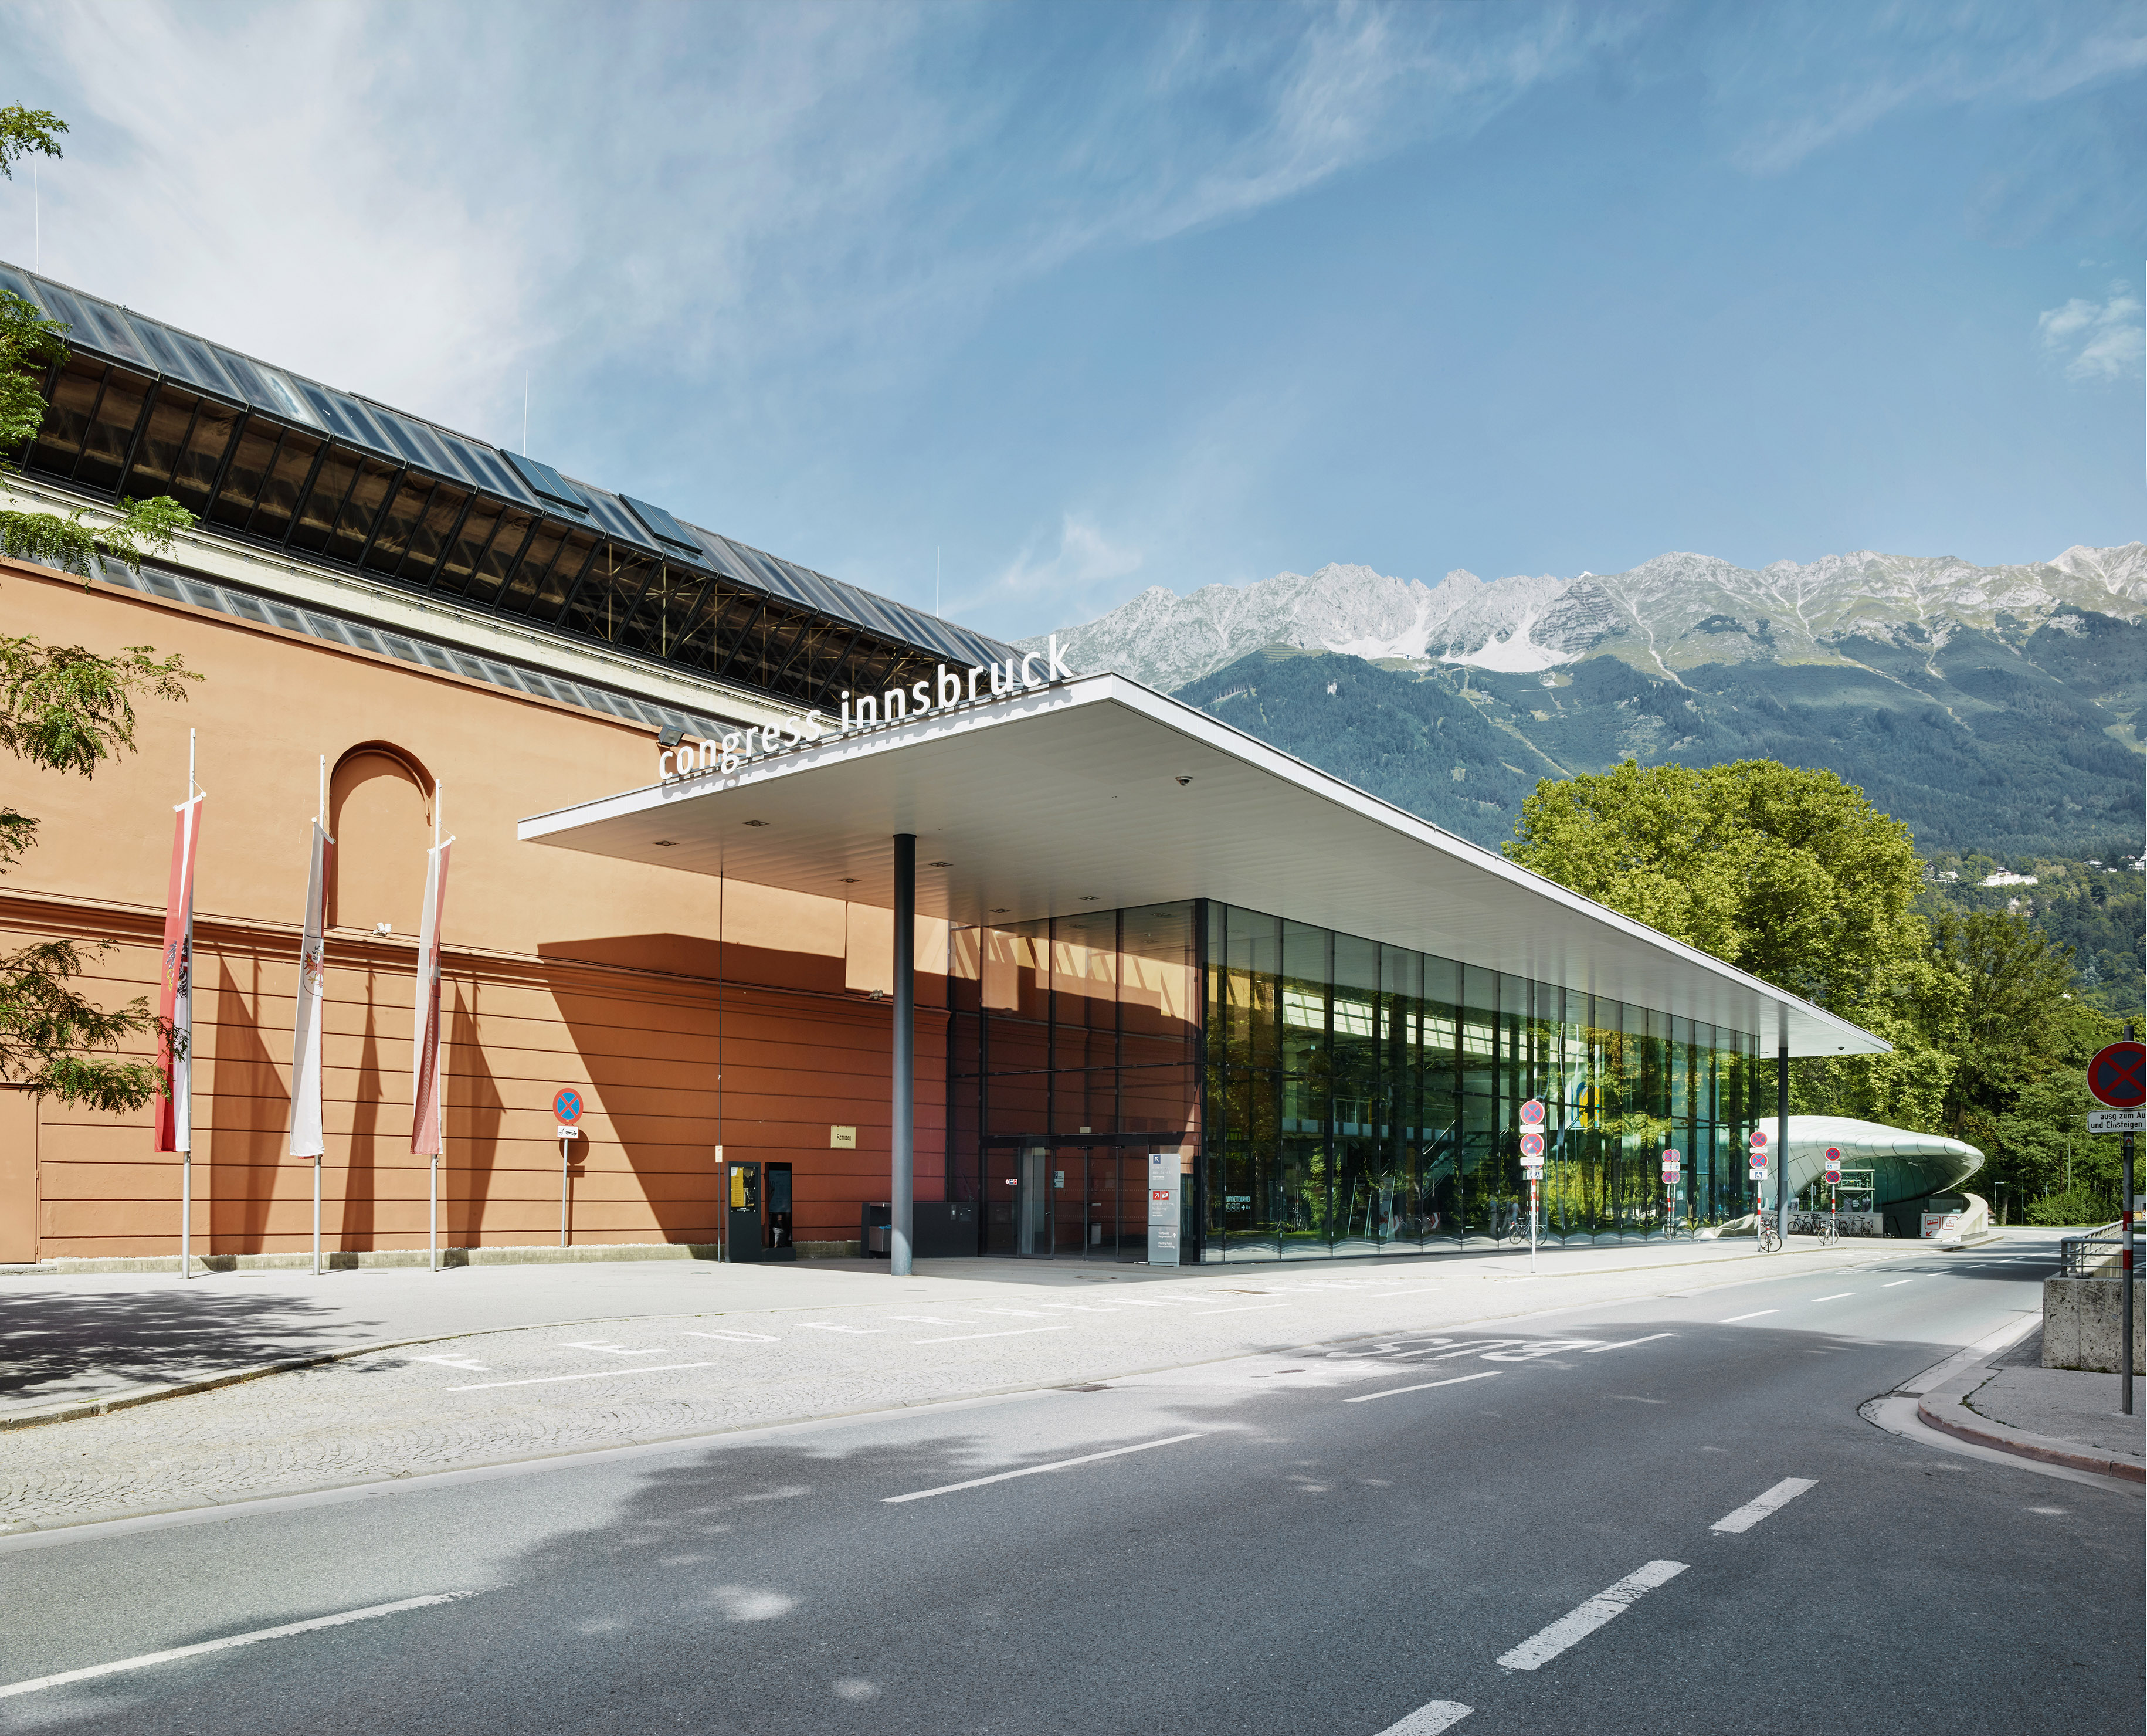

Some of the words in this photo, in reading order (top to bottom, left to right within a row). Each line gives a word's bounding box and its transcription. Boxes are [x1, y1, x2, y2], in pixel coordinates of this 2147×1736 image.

[659, 709, 822, 781] congress
[841, 633, 1074, 733] innsbruck
[2106, 1121, 2142, 1129] Einsteigen
[1325, 1337, 1606, 1362] BUS
